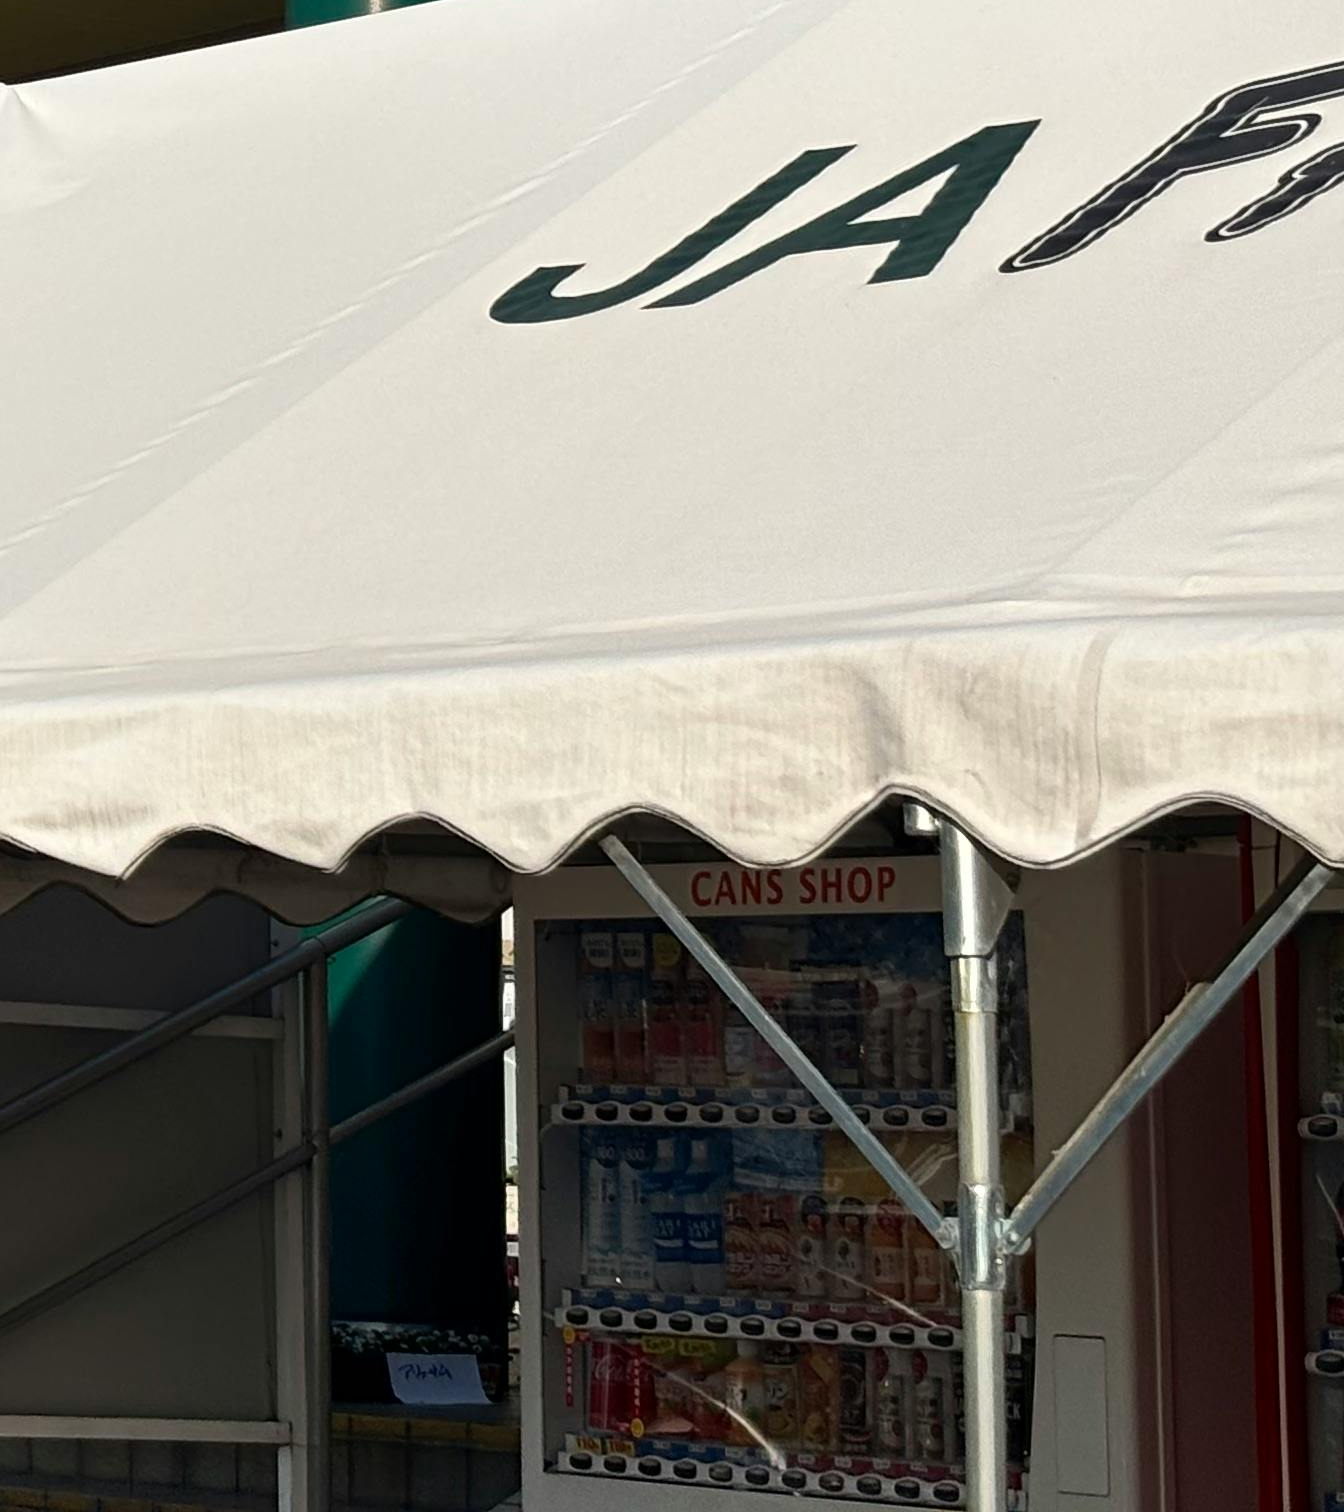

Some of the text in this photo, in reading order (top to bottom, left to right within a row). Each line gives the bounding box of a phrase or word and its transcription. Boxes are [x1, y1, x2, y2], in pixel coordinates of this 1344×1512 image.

[487, 118, 1042, 325] JA
[691, 866, 895, 906] CANS SHOP
